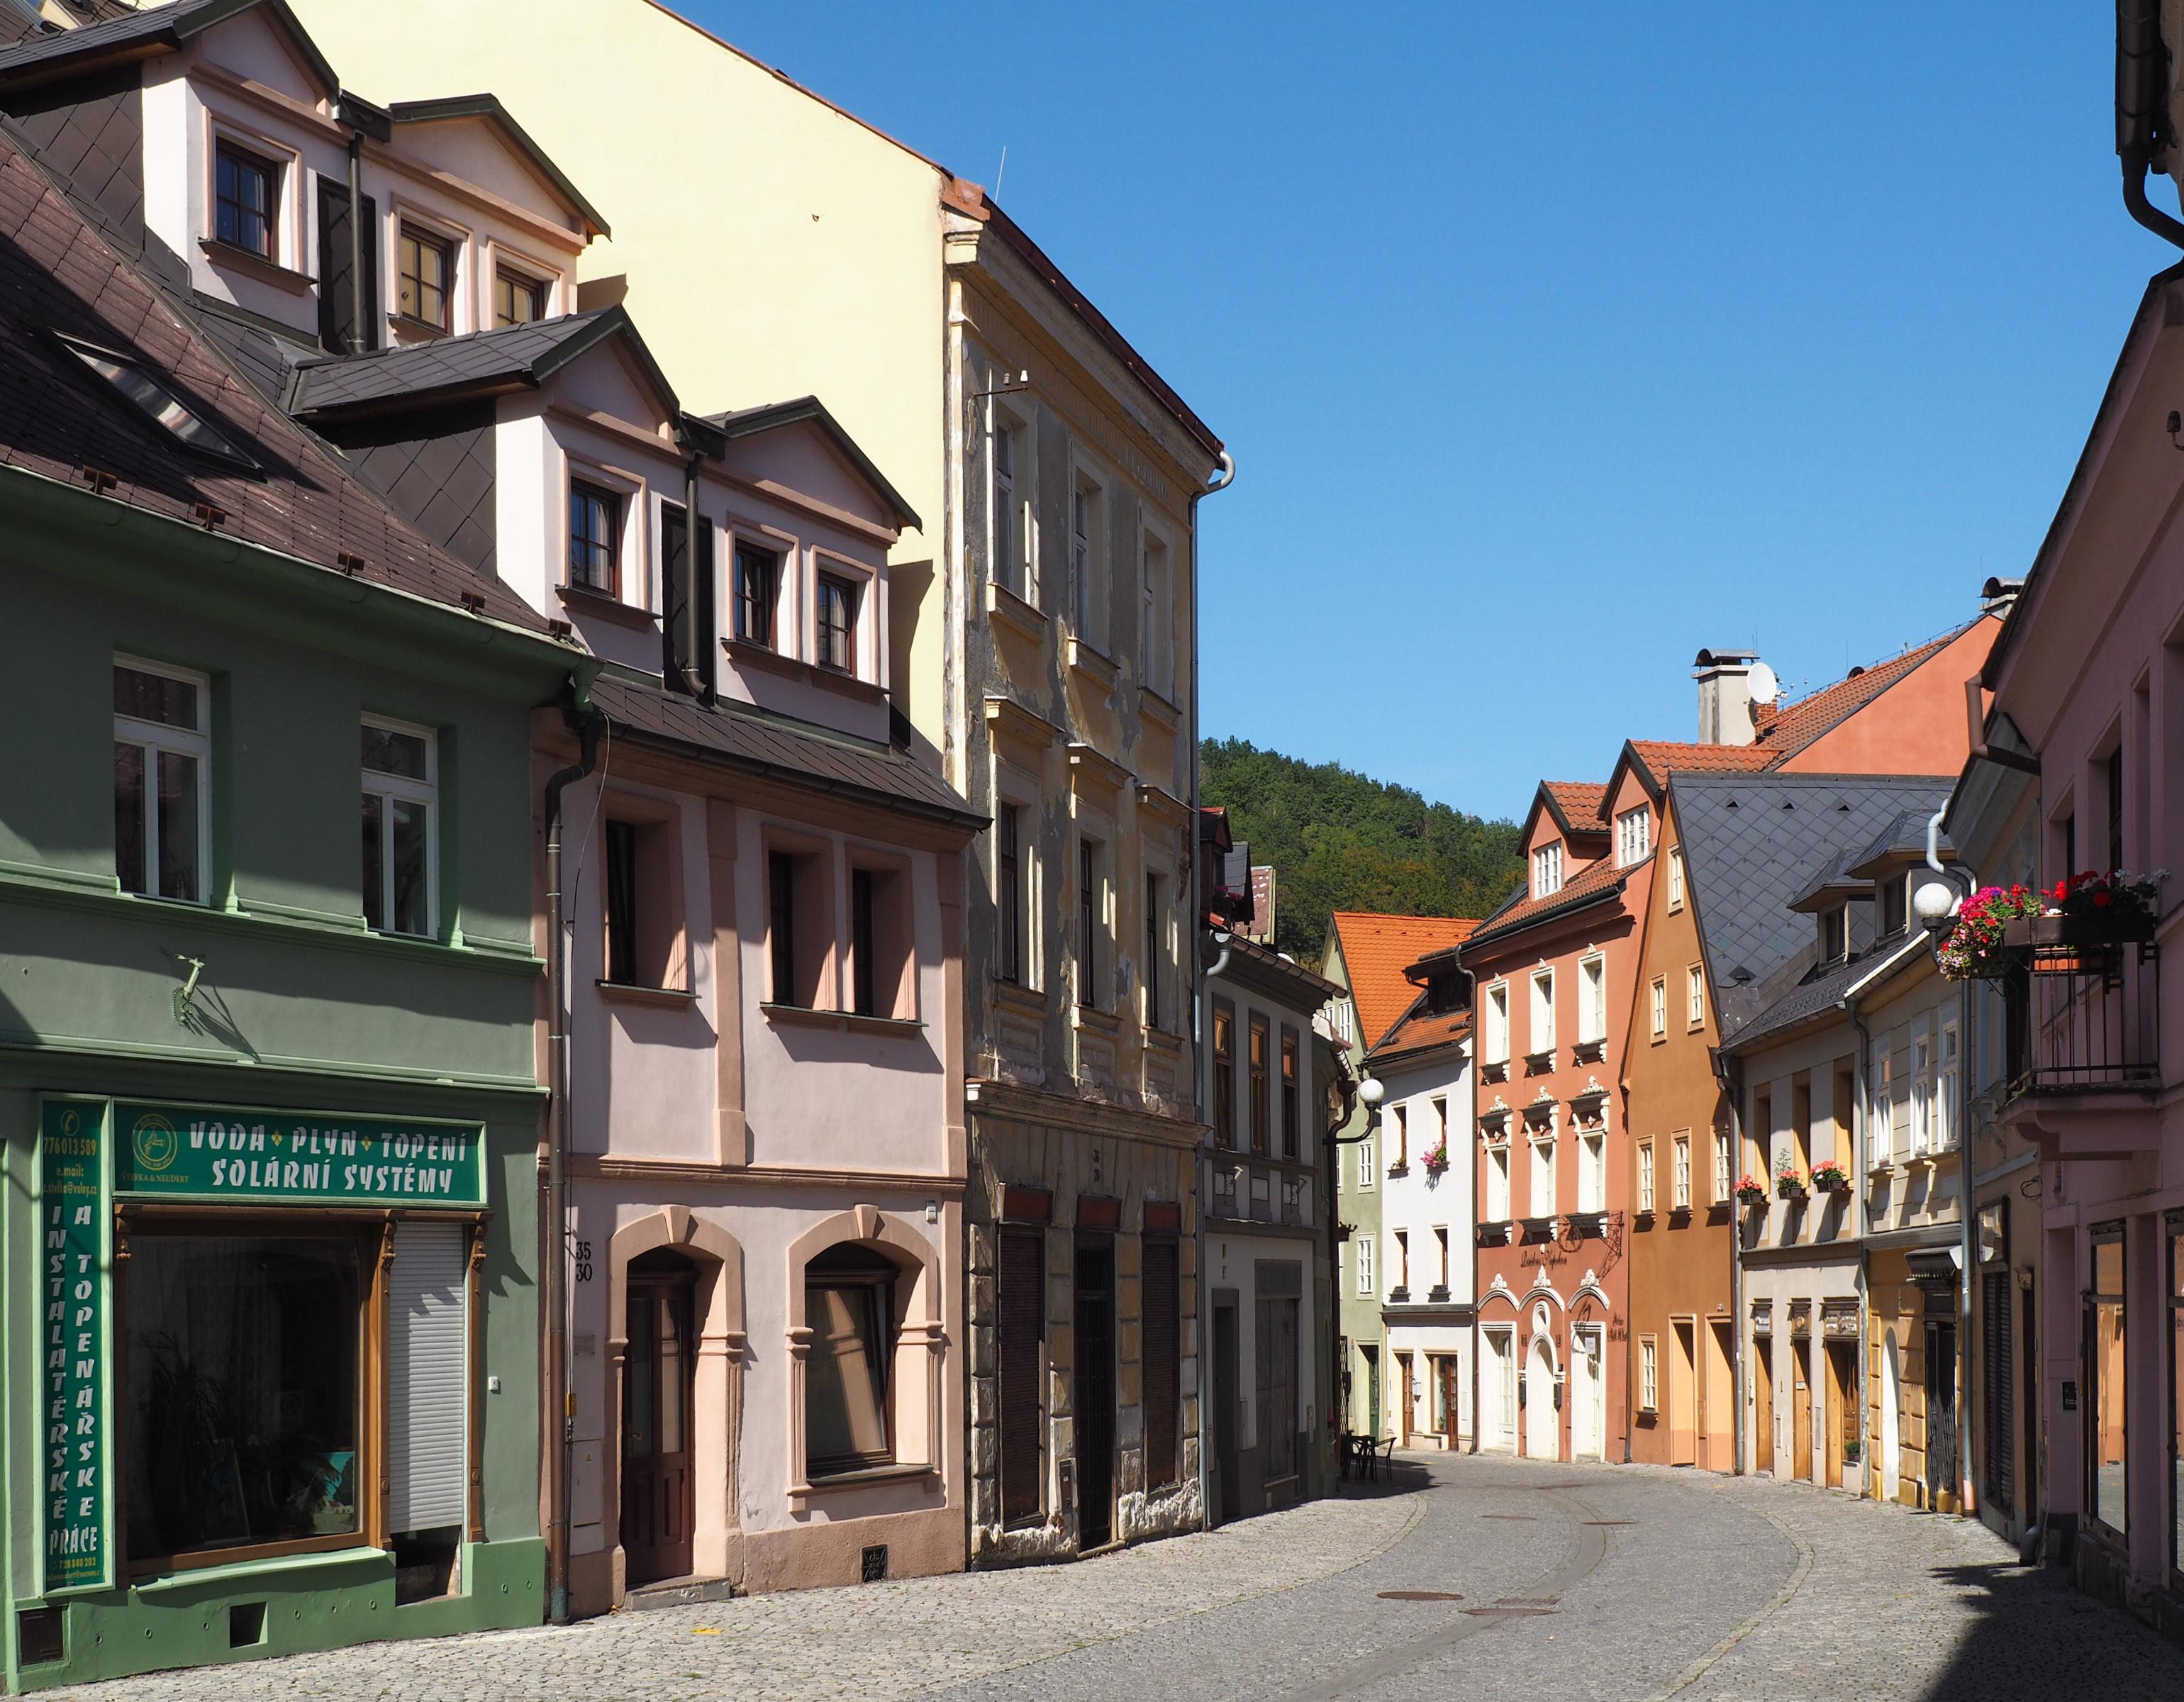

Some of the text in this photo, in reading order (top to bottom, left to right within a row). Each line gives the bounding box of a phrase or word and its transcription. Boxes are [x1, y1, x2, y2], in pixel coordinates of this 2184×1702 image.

[190, 1121, 265, 1152] VODA
[292, 1125, 357, 1157] PLYN
[381, 1133, 467, 1162] TOPENÍ
[156, 1174, 189, 1183] NEUDERT
[212, 1156, 453, 1194] SOLÁRNÍ SYSTÉMY
[74, 1206, 91, 1225] A
[576, 1242, 591, 1260] 35
[576, 1263, 593, 1281] 30
[48, 1206, 69, 1518] INSTALATÉRSKÉ
[50, 1523, 98, 1555] PRÁCE
